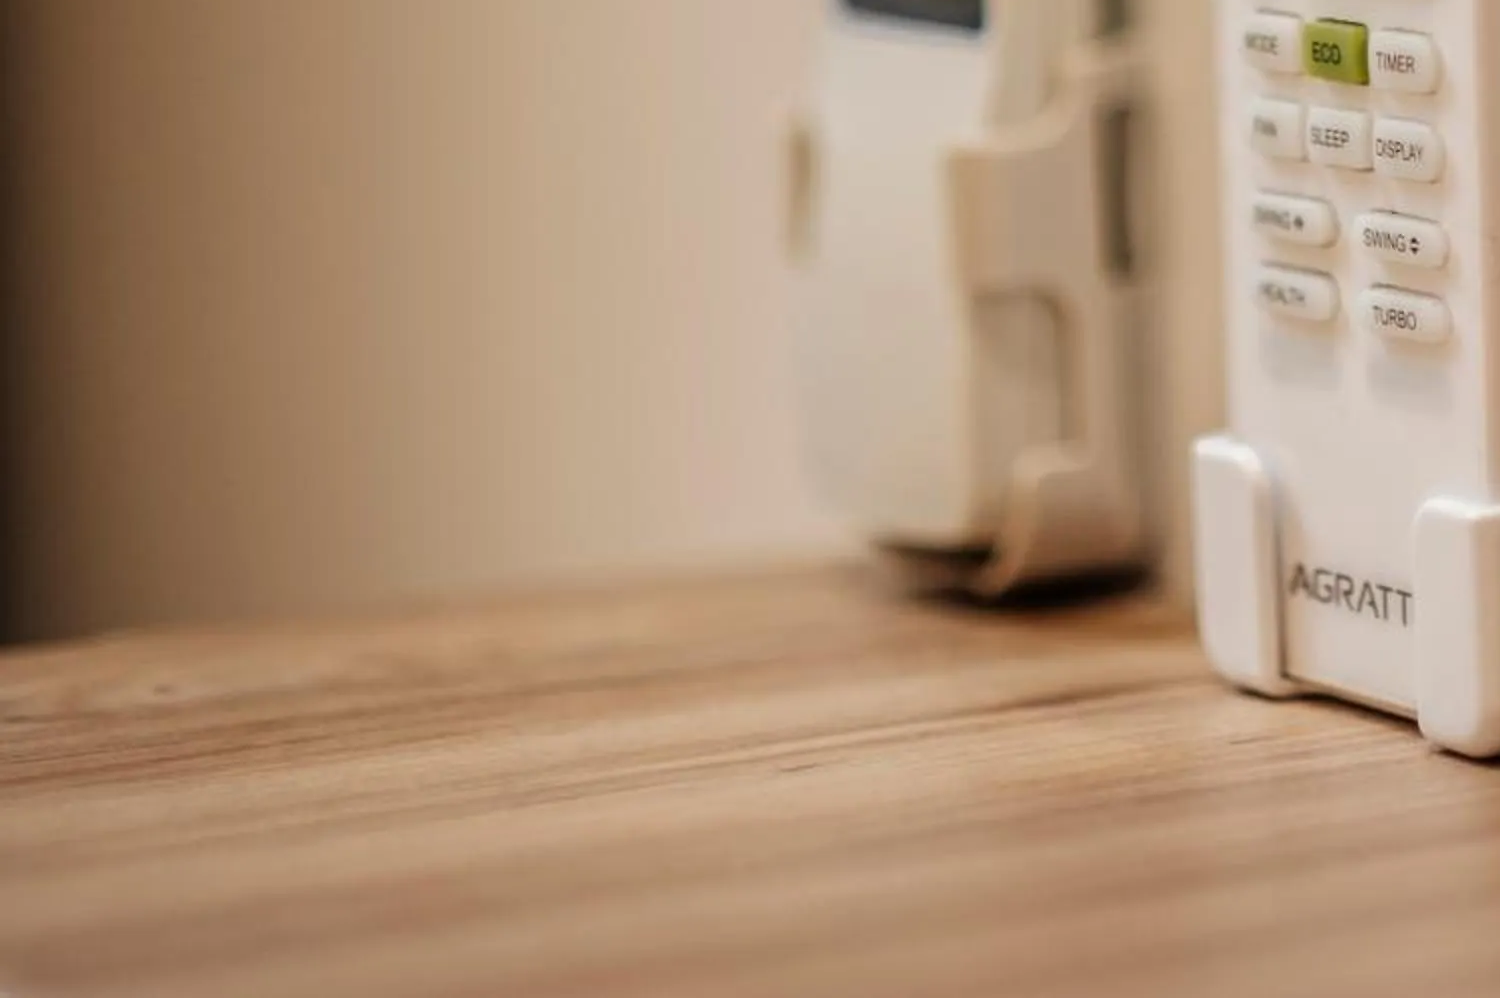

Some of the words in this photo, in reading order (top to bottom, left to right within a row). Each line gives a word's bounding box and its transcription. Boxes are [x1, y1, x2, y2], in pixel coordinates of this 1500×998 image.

[1312, 41, 1342, 66] ECO
[1375, 50, 1416, 75] TIMER
[1310, 126, 1350, 149] SLEEP
[1375, 138, 1424, 163] DISPLAY
[1362, 228, 1407, 254] SWING
[1372, 304, 1418, 331] TURBO
[1289, 561, 1413, 628] AGRATT
